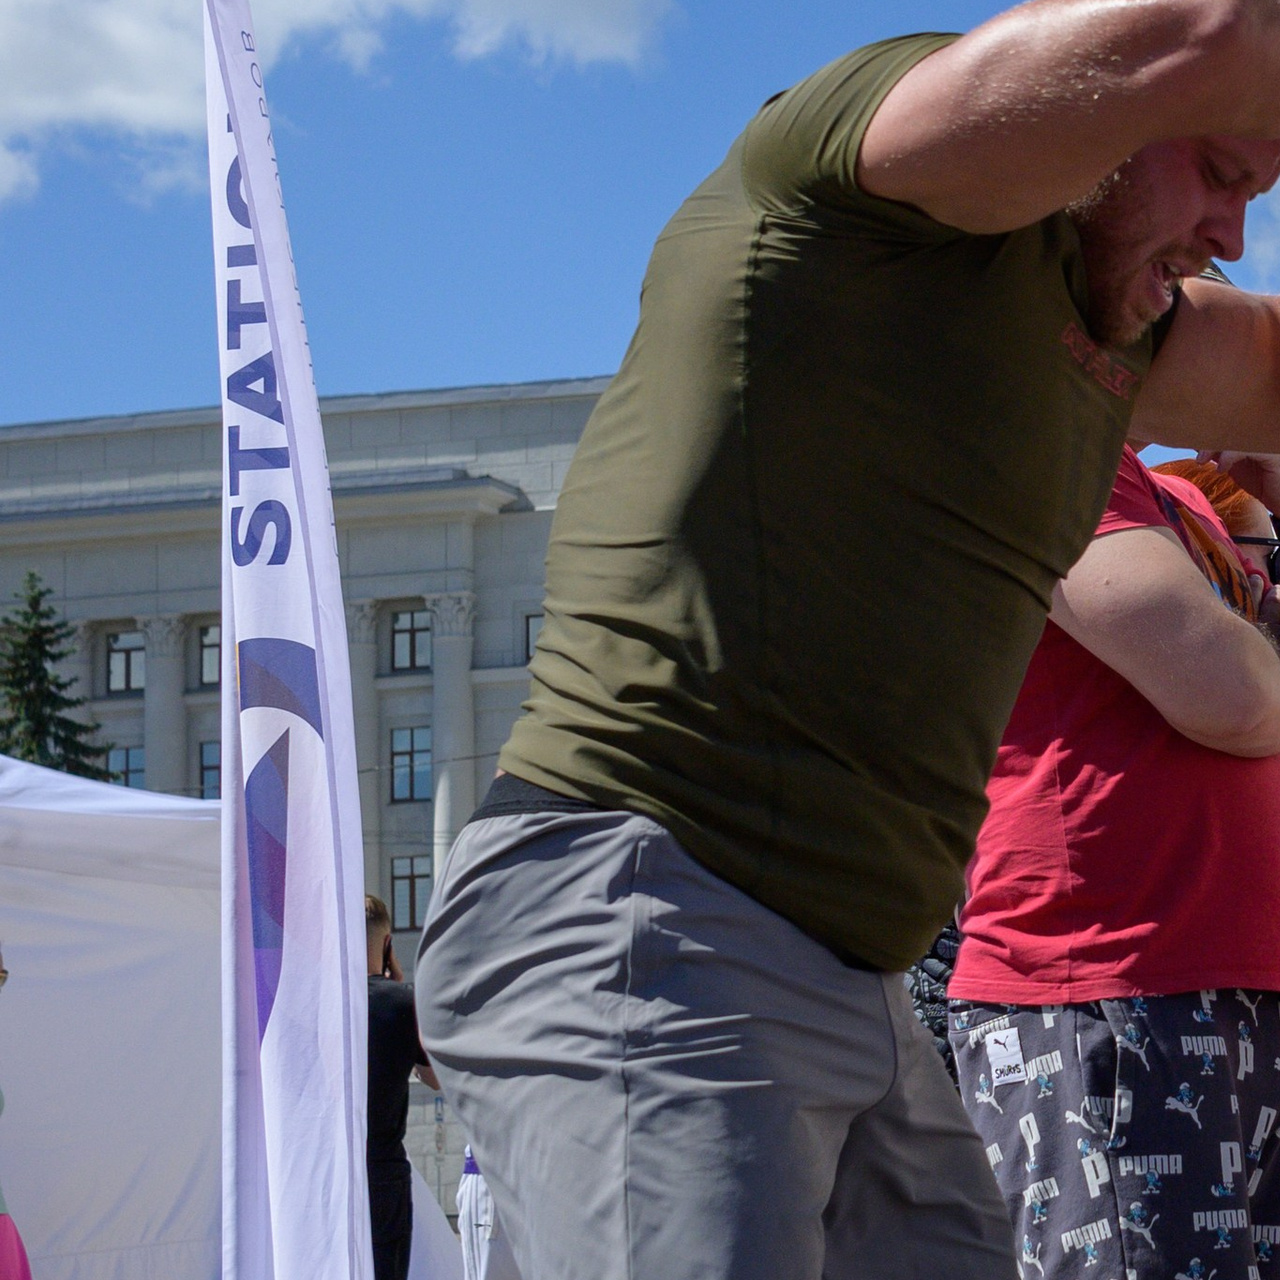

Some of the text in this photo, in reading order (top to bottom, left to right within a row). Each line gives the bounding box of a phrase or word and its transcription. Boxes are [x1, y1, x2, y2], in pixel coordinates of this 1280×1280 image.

[1180, 1036, 1228, 1056] PUMA
[1118, 1154, 1183, 1177] PUMA
[1192, 1209, 1248, 1232] PUMA
[1061, 1217, 1113, 1254] PUMA
